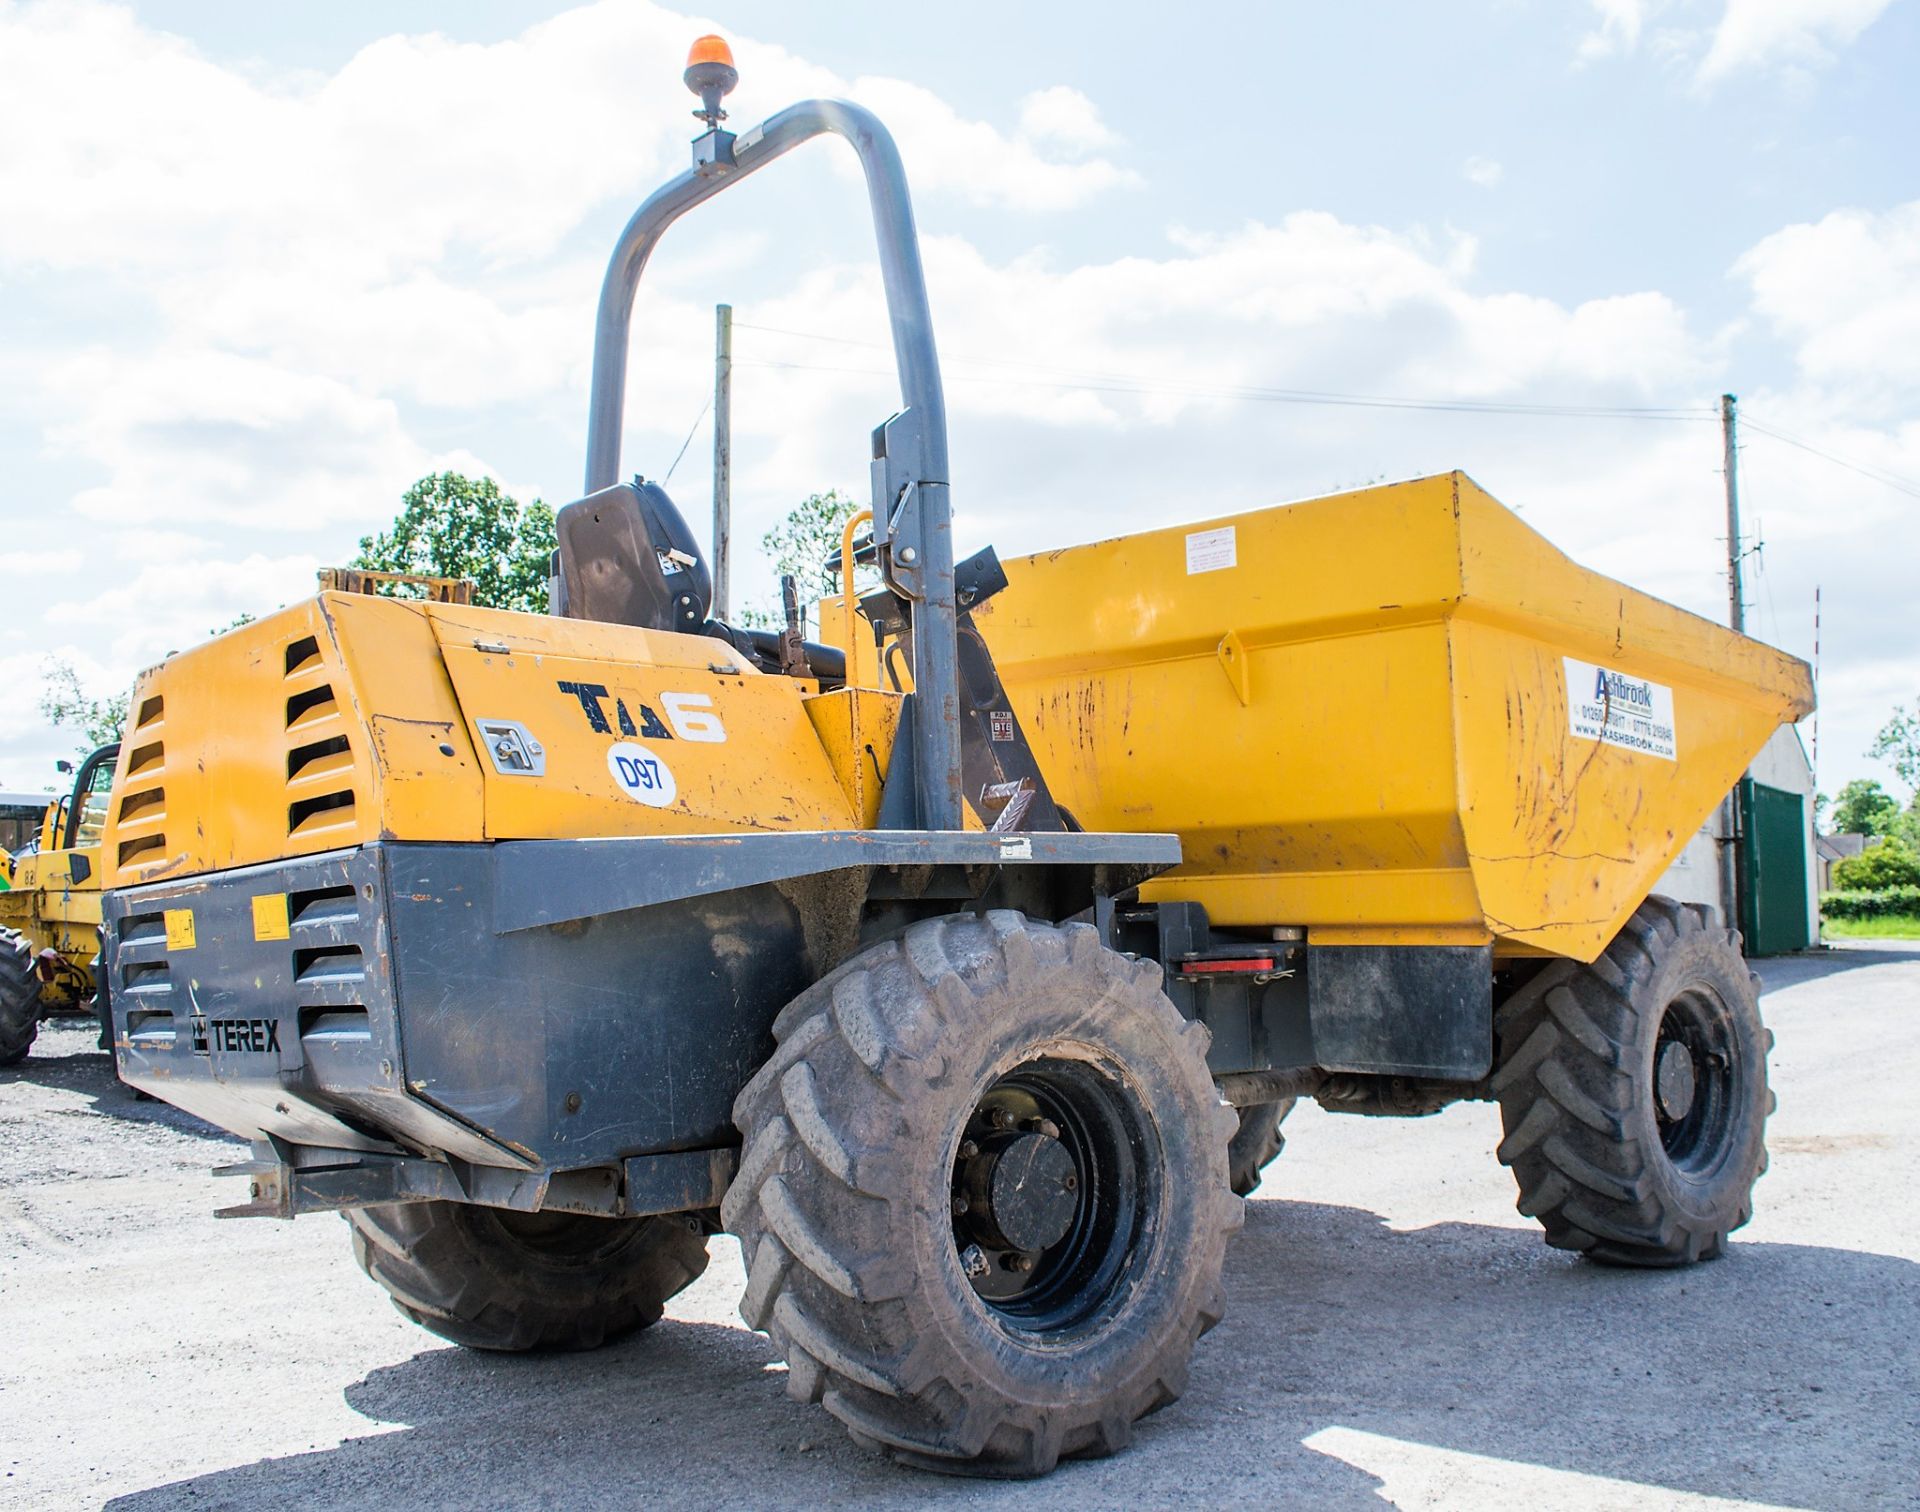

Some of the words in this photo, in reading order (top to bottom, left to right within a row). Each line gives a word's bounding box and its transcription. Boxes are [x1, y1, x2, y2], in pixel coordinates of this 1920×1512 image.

[1595, 668, 1652, 707] Ashbrook
[615, 755, 663, 790] D97
[210, 1019, 281, 1053] TEREX
